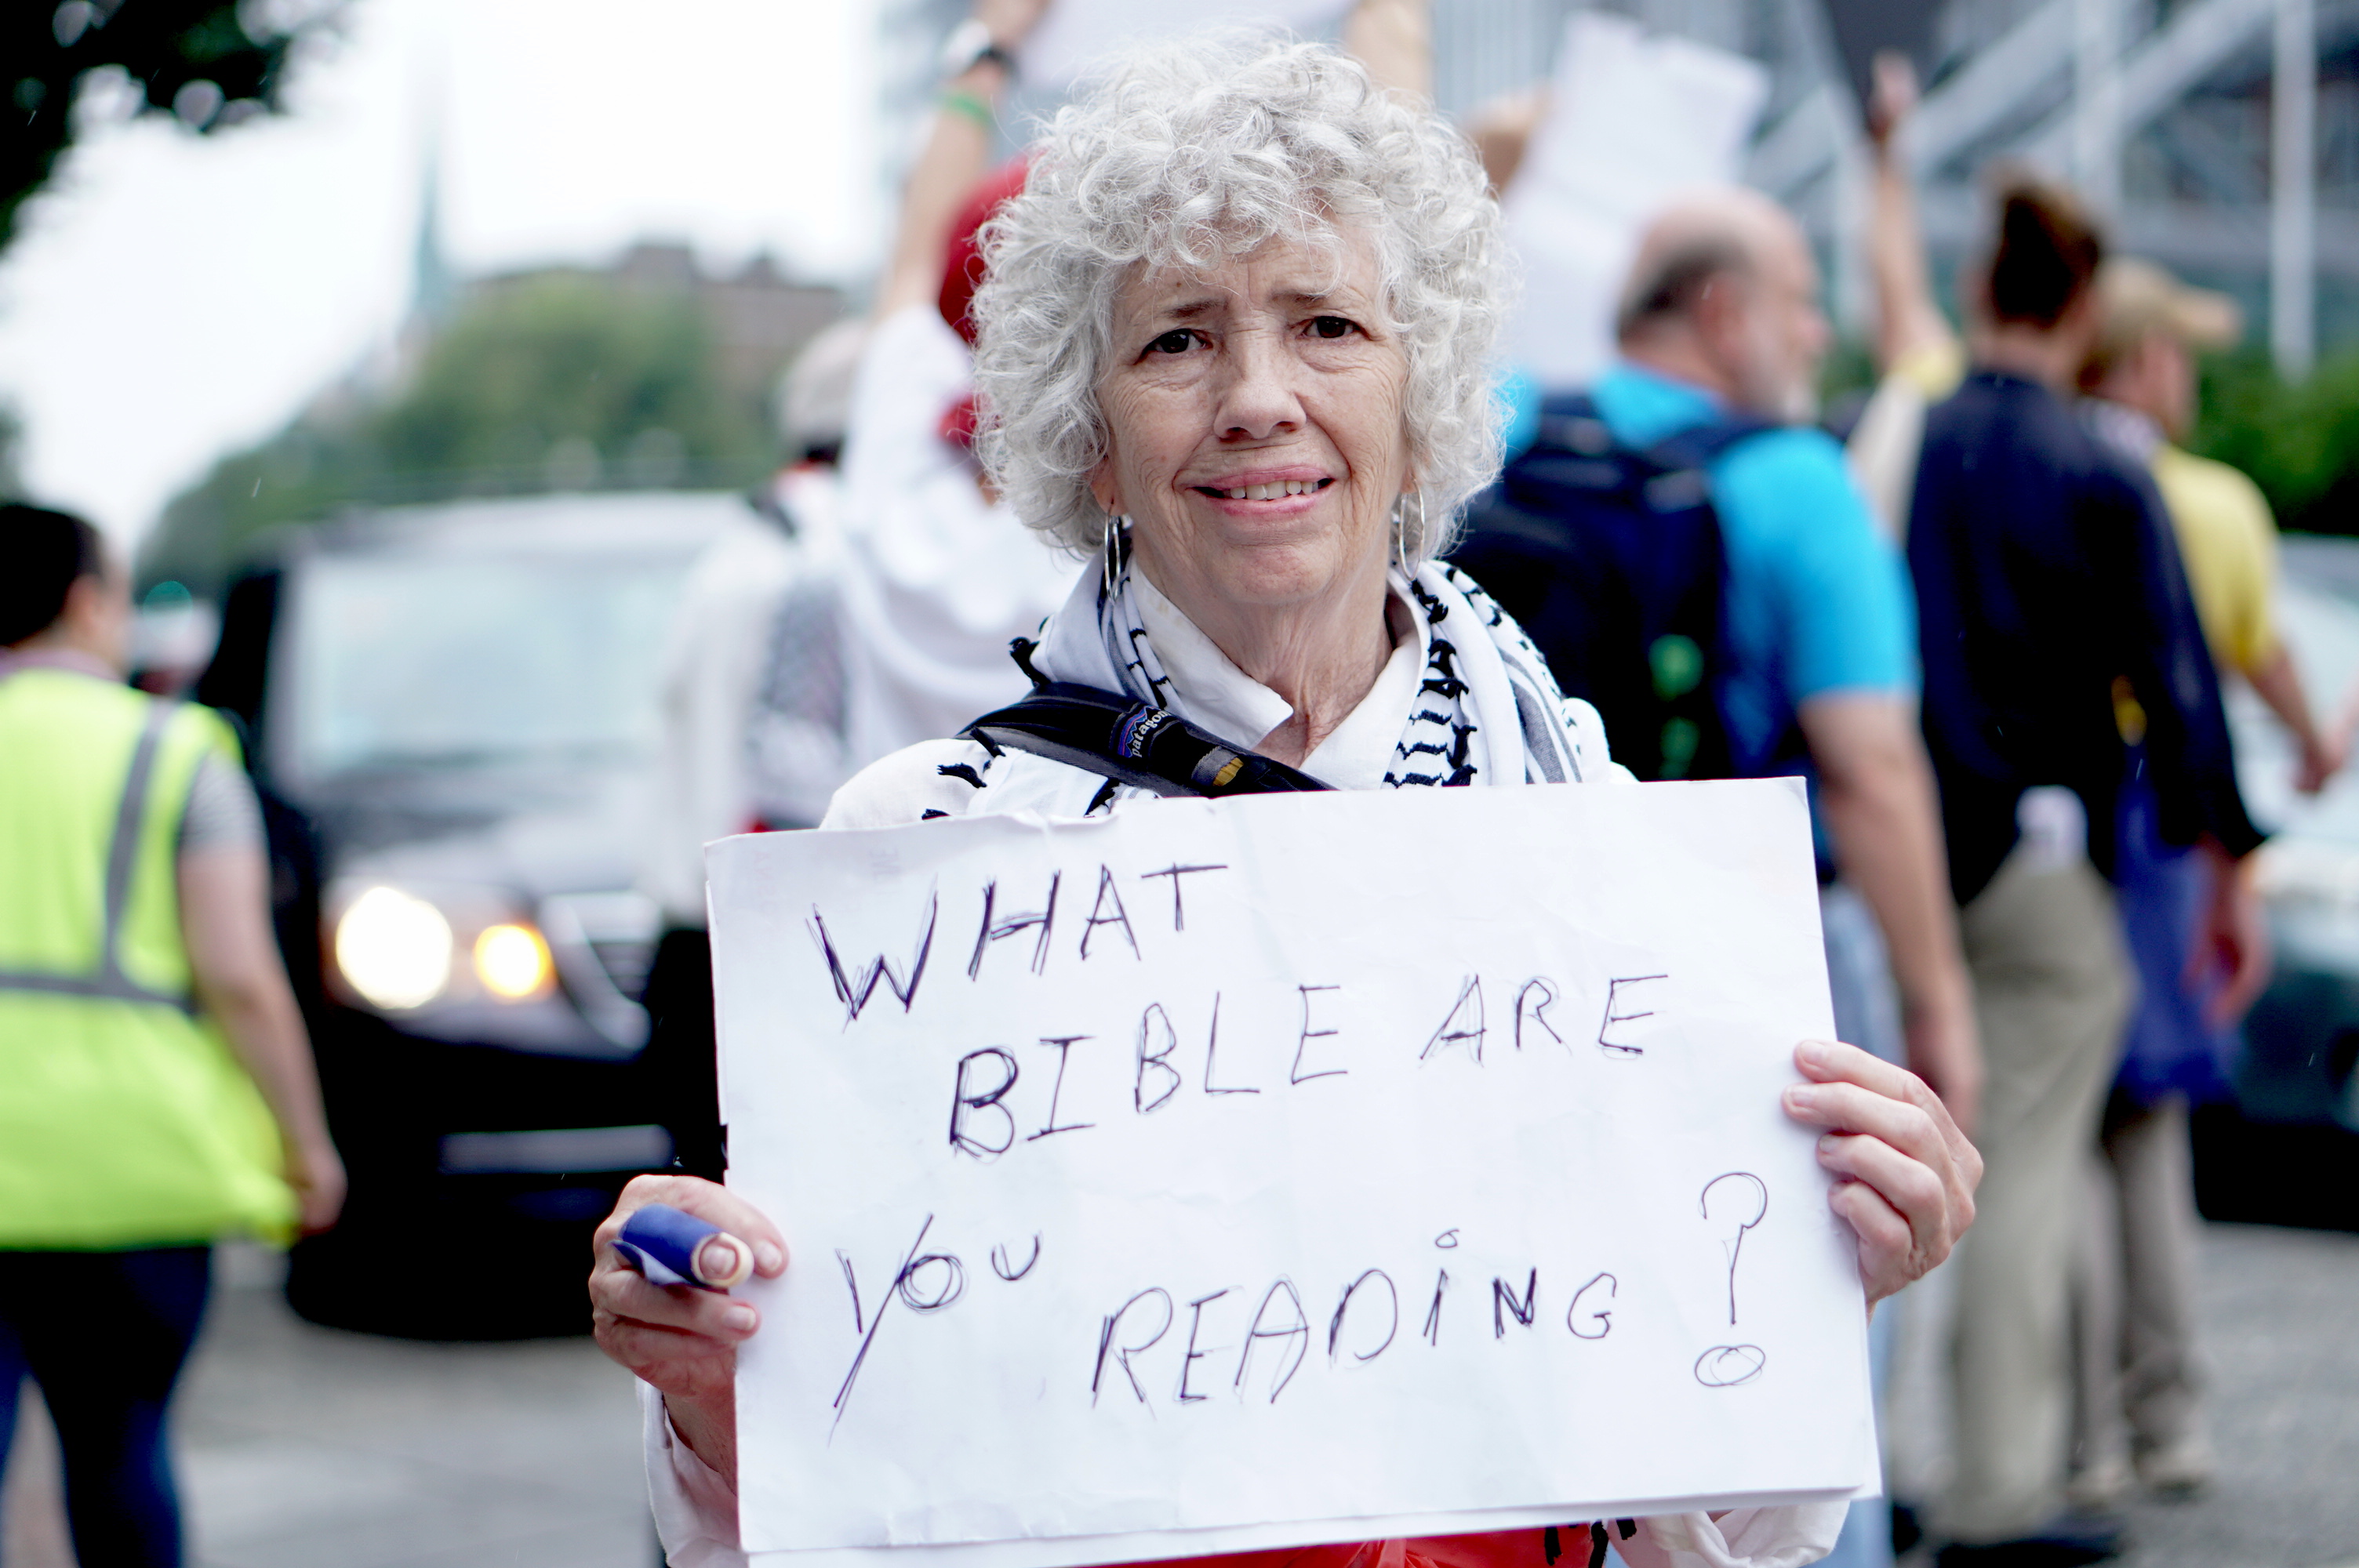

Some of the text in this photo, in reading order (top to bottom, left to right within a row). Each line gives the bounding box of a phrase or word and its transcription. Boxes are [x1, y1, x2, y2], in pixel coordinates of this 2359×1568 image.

[1132, 710, 1174, 757] patagon
[805, 863, 1229, 1033] WHAT
[947, 974, 1668, 1163] BIBLE ARE
